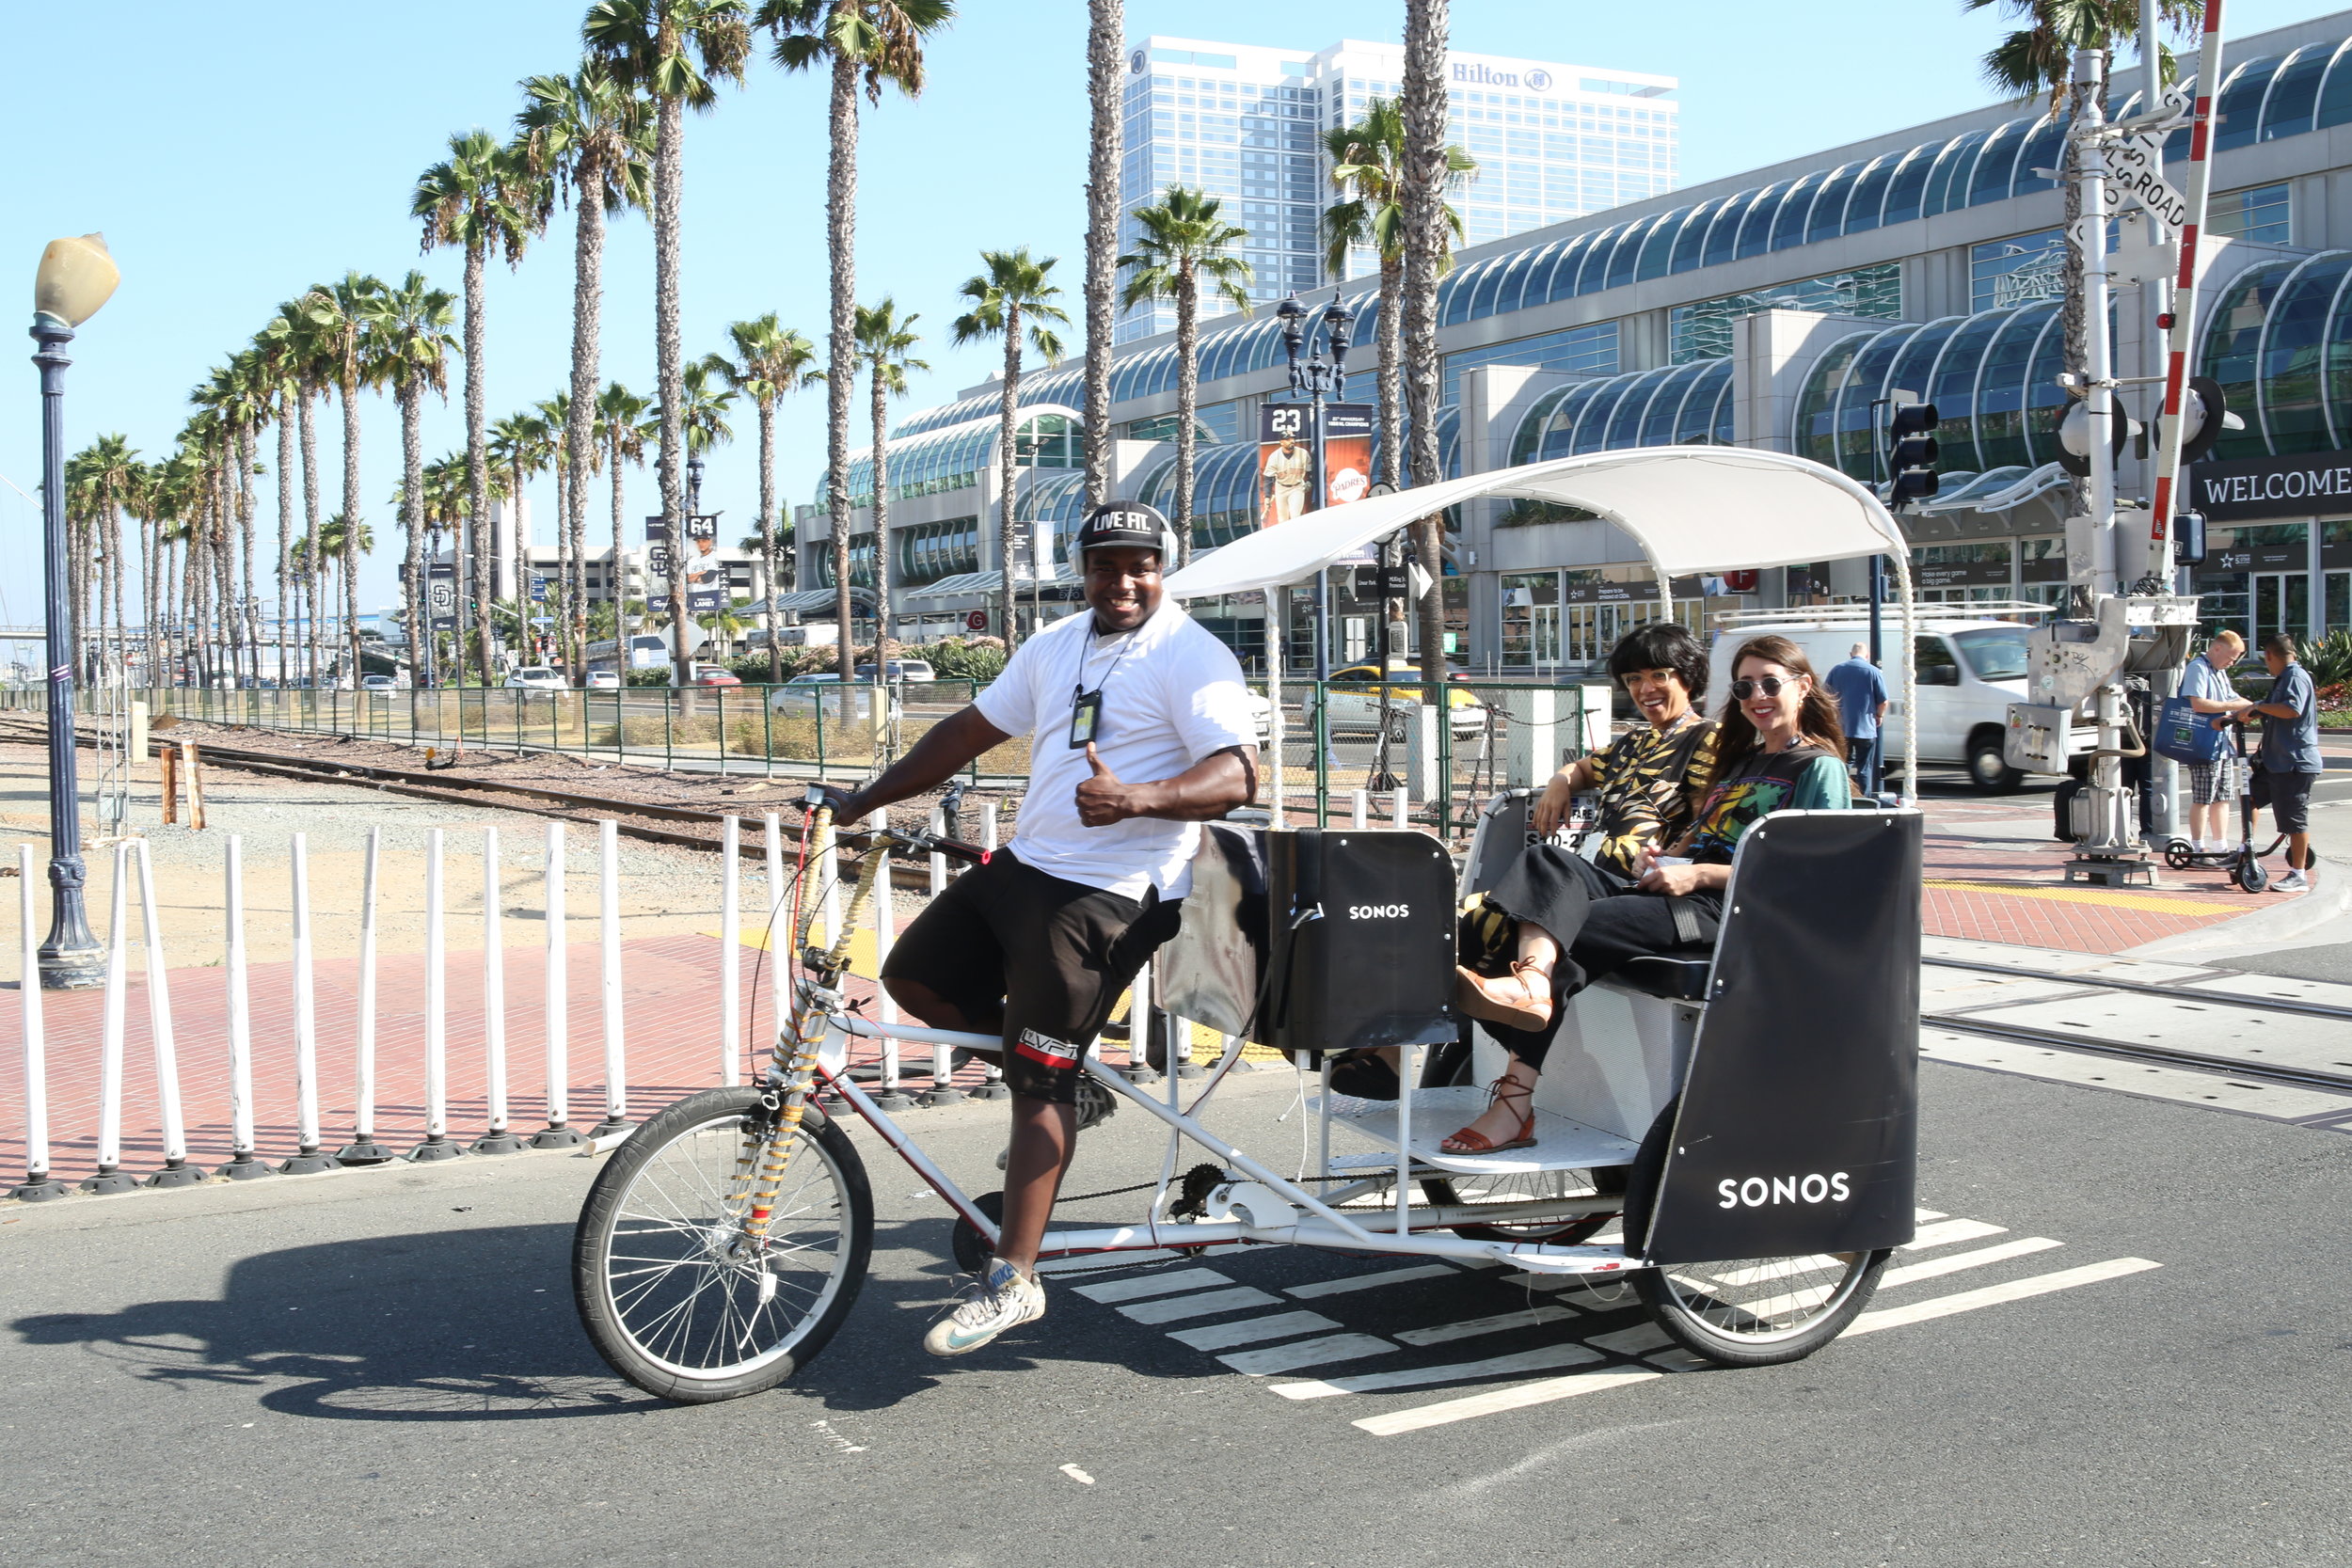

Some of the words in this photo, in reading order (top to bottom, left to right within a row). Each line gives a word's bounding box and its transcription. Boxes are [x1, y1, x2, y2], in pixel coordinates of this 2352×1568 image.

[1453, 63, 1519, 87] Hilton
[1272, 409, 1301, 433] 23
[1332, 476, 1366, 497] PADRES
[2204, 467, 2352, 503] WELCOME
[690, 517, 713, 534] 64
[1093, 512, 1124, 532] LIVE
[1950, 570, 1967, 578] game
[1058, 591, 1080, 599] EXPO
[972, 614, 983, 626] G
[1572, 809, 1593, 820] FARE
[1349, 904, 1409, 920] SONOS
[1718, 1172, 1850, 1209] SONOS
[990, 1264, 1014, 1288] NIKE
